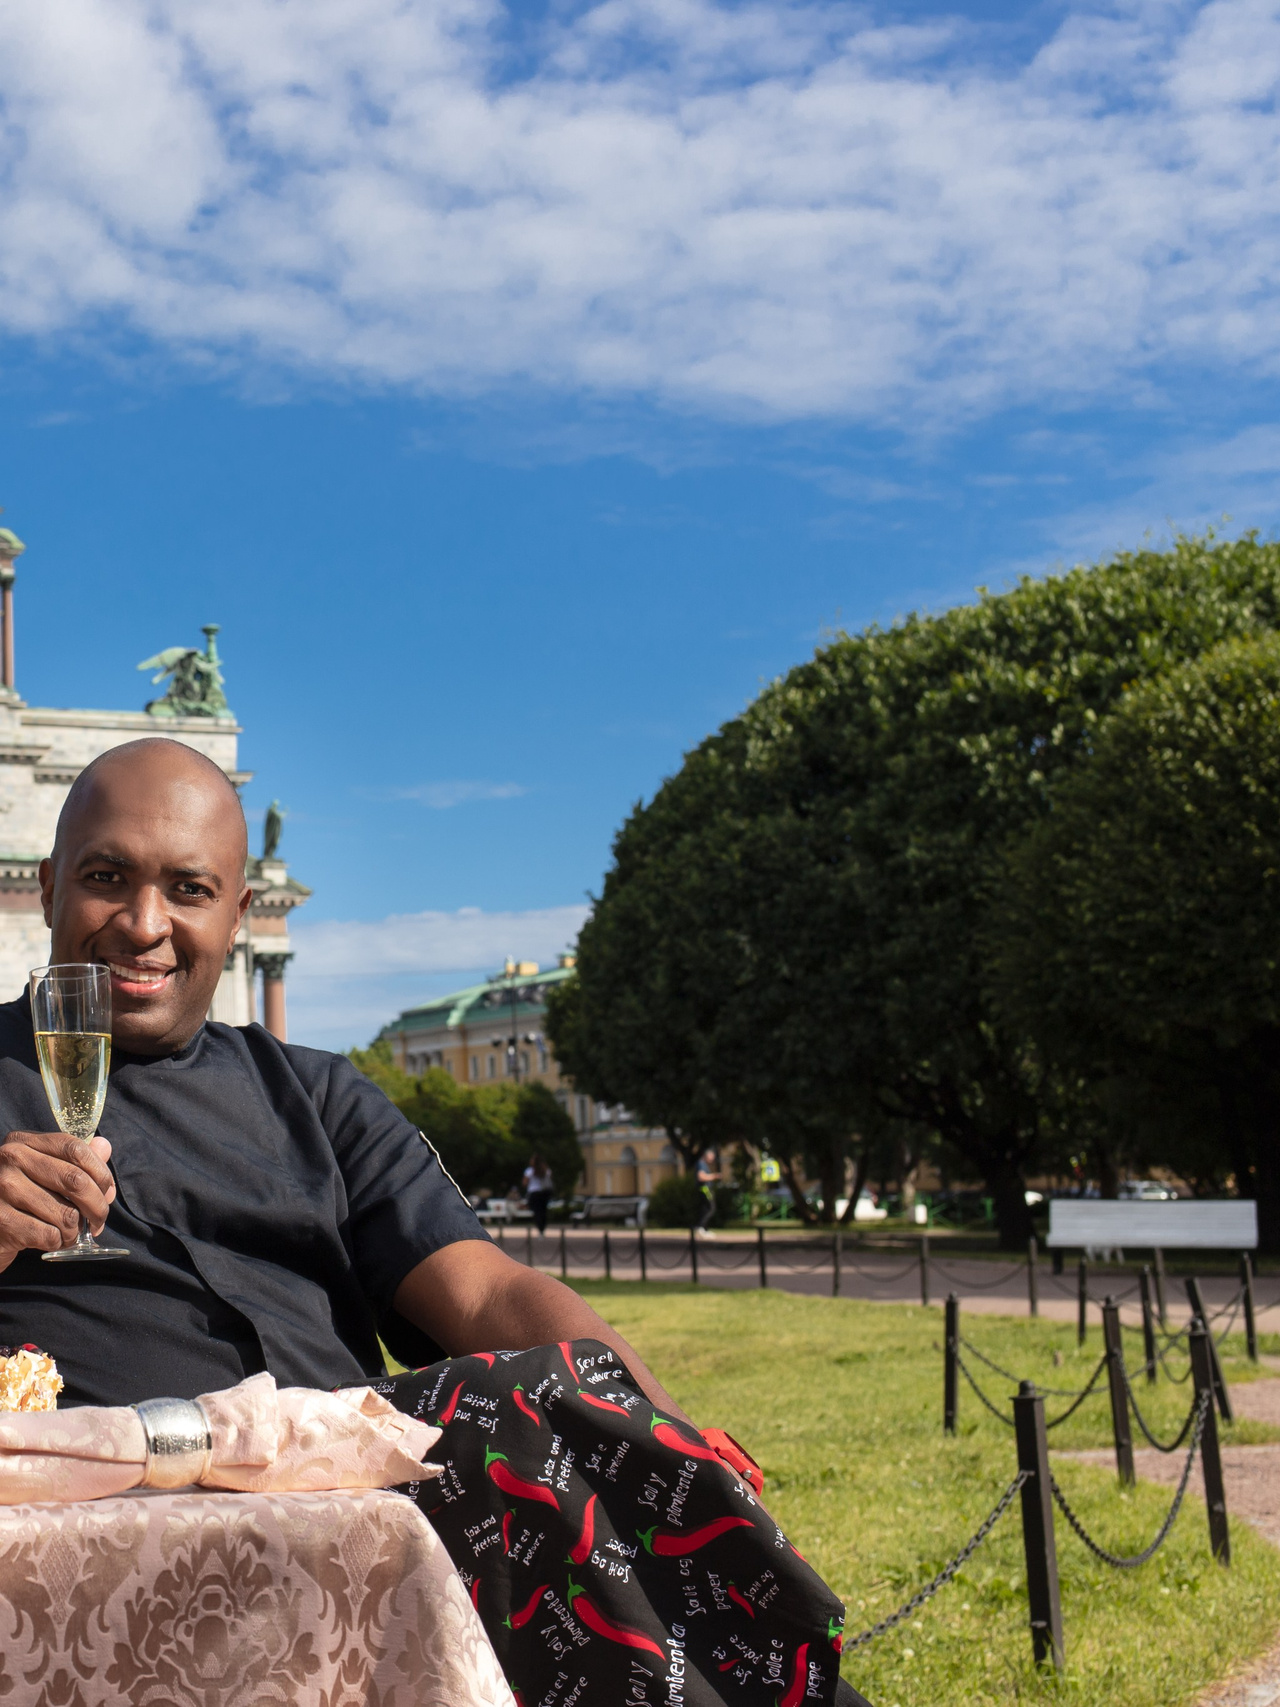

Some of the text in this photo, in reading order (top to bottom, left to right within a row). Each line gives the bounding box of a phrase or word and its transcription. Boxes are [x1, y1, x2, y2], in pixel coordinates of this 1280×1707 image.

[666, 1460, 698, 1527] pimienta
[543, 1589, 591, 1647] pimienta
[563, 1676, 589, 1707] oivre
[664, 1623, 686, 1707] imienta
[806, 1661, 824, 1699] pepe
